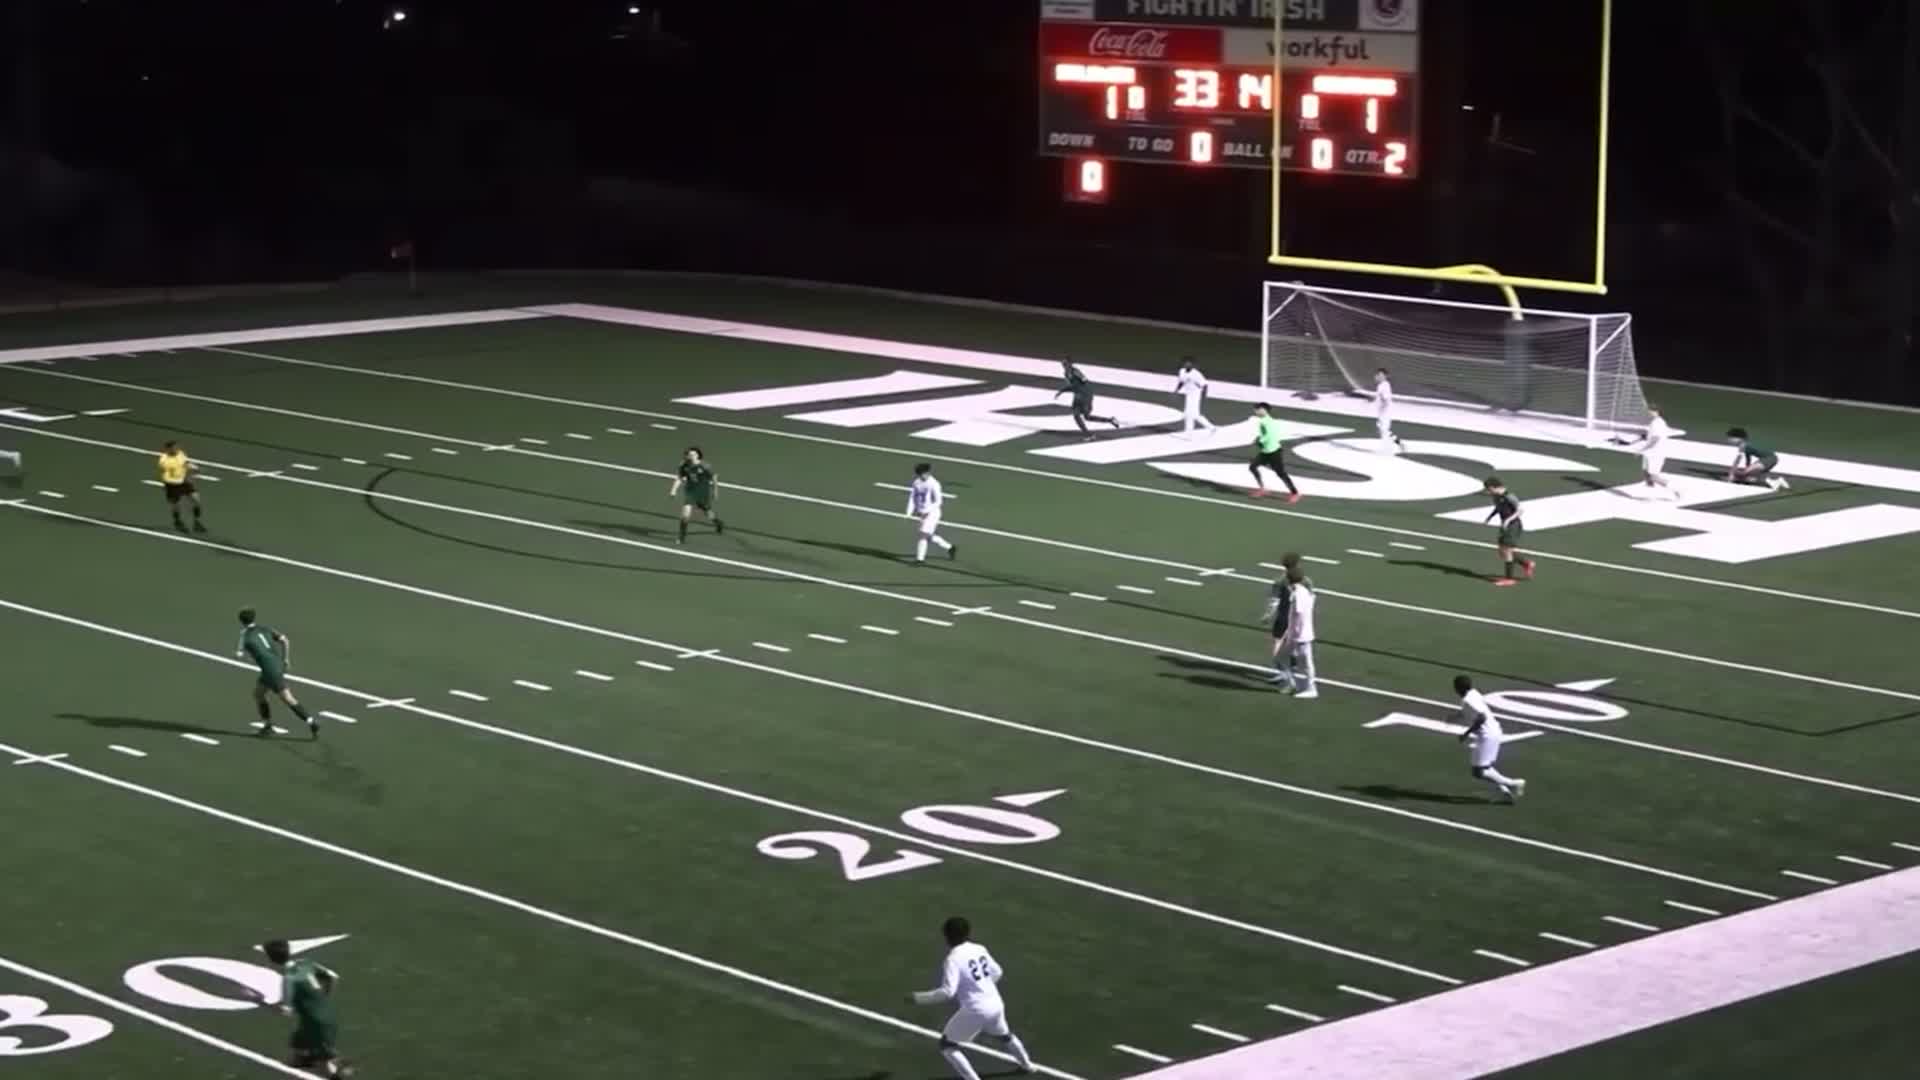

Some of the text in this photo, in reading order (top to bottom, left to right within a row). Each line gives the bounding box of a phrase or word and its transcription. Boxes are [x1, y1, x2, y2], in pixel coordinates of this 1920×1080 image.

[1106, 85, 1118, 120] 1
[1174, 69, 1219, 108] 33
[1365, 97, 1378, 134] 1
[1049, 133, 1095, 147] DOWN
[1128, 136, 1174, 152] TO GO
[1190, 131, 1213, 163] 0
[1224, 142, 1265, 158] BALL
[1312, 138, 1334, 170] 0
[1383, 141, 1407, 175] 2
[1081, 160, 1104, 193] 0
[757, 804, 1061, 881] 20
[968, 955, 990, 982] 22
